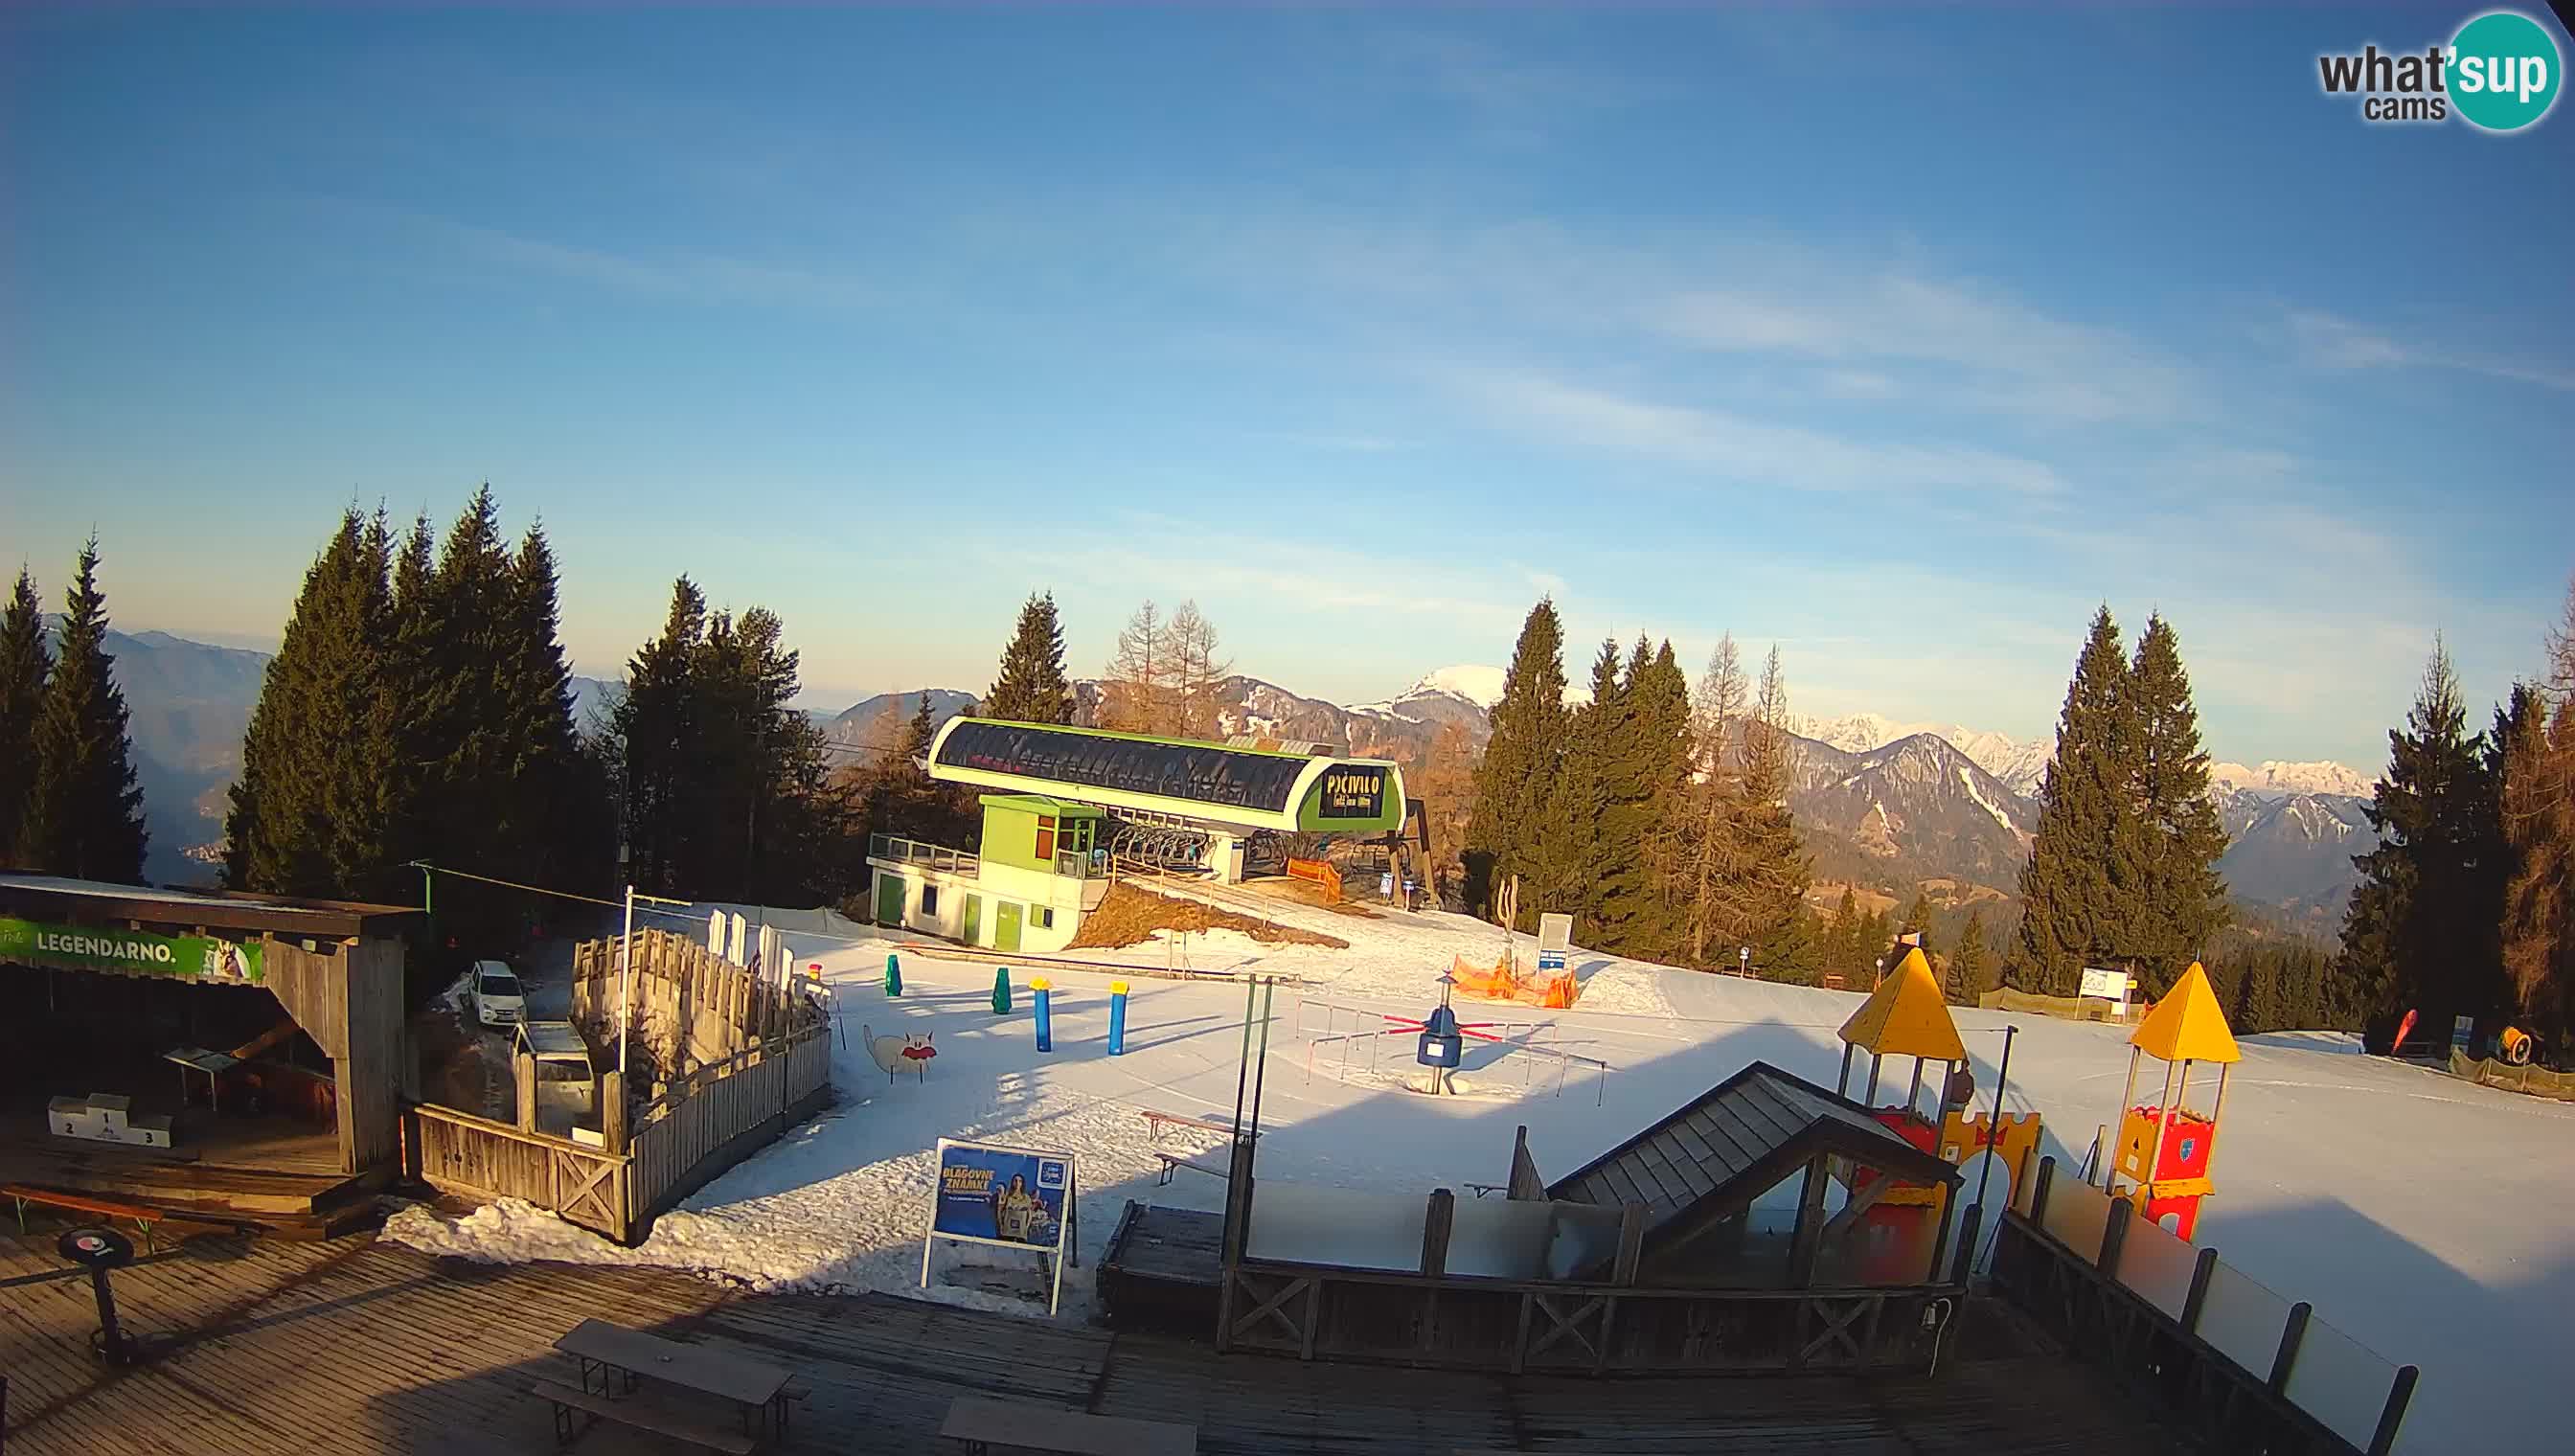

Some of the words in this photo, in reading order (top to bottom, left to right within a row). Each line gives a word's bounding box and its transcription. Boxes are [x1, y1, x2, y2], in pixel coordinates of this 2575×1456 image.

[38, 932, 176, 964] LEGENDARNO.
[103, 1112, 109, 1124] 1
[65, 1123, 74, 1134] 2
[146, 1132, 154, 1144] 3
[946, 1178, 991, 1191] ZNAMKE
